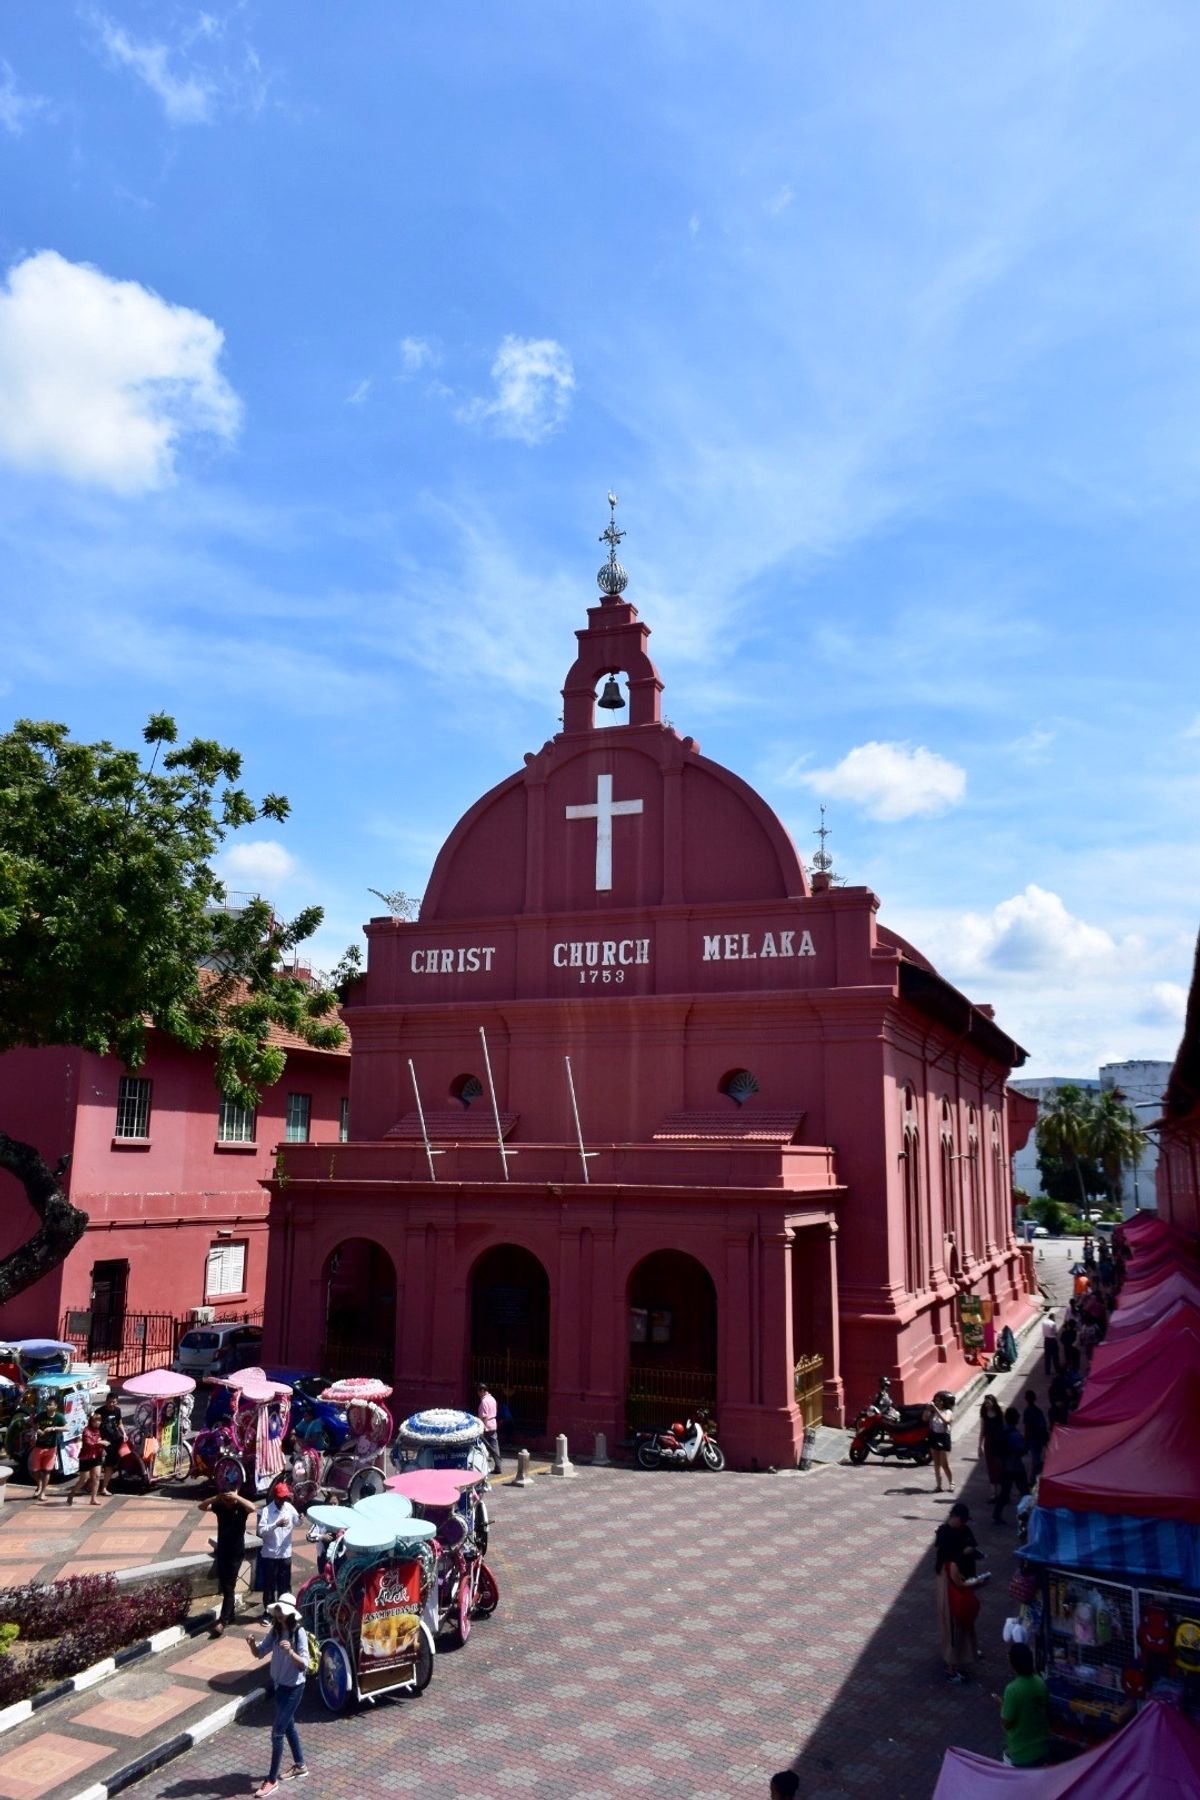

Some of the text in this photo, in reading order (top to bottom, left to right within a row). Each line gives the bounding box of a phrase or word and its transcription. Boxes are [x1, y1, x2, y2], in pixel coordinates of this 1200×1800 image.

[411, 930, 817, 973] CHRIST CHURCH MELAKA
[579, 969, 625, 984] 1753
